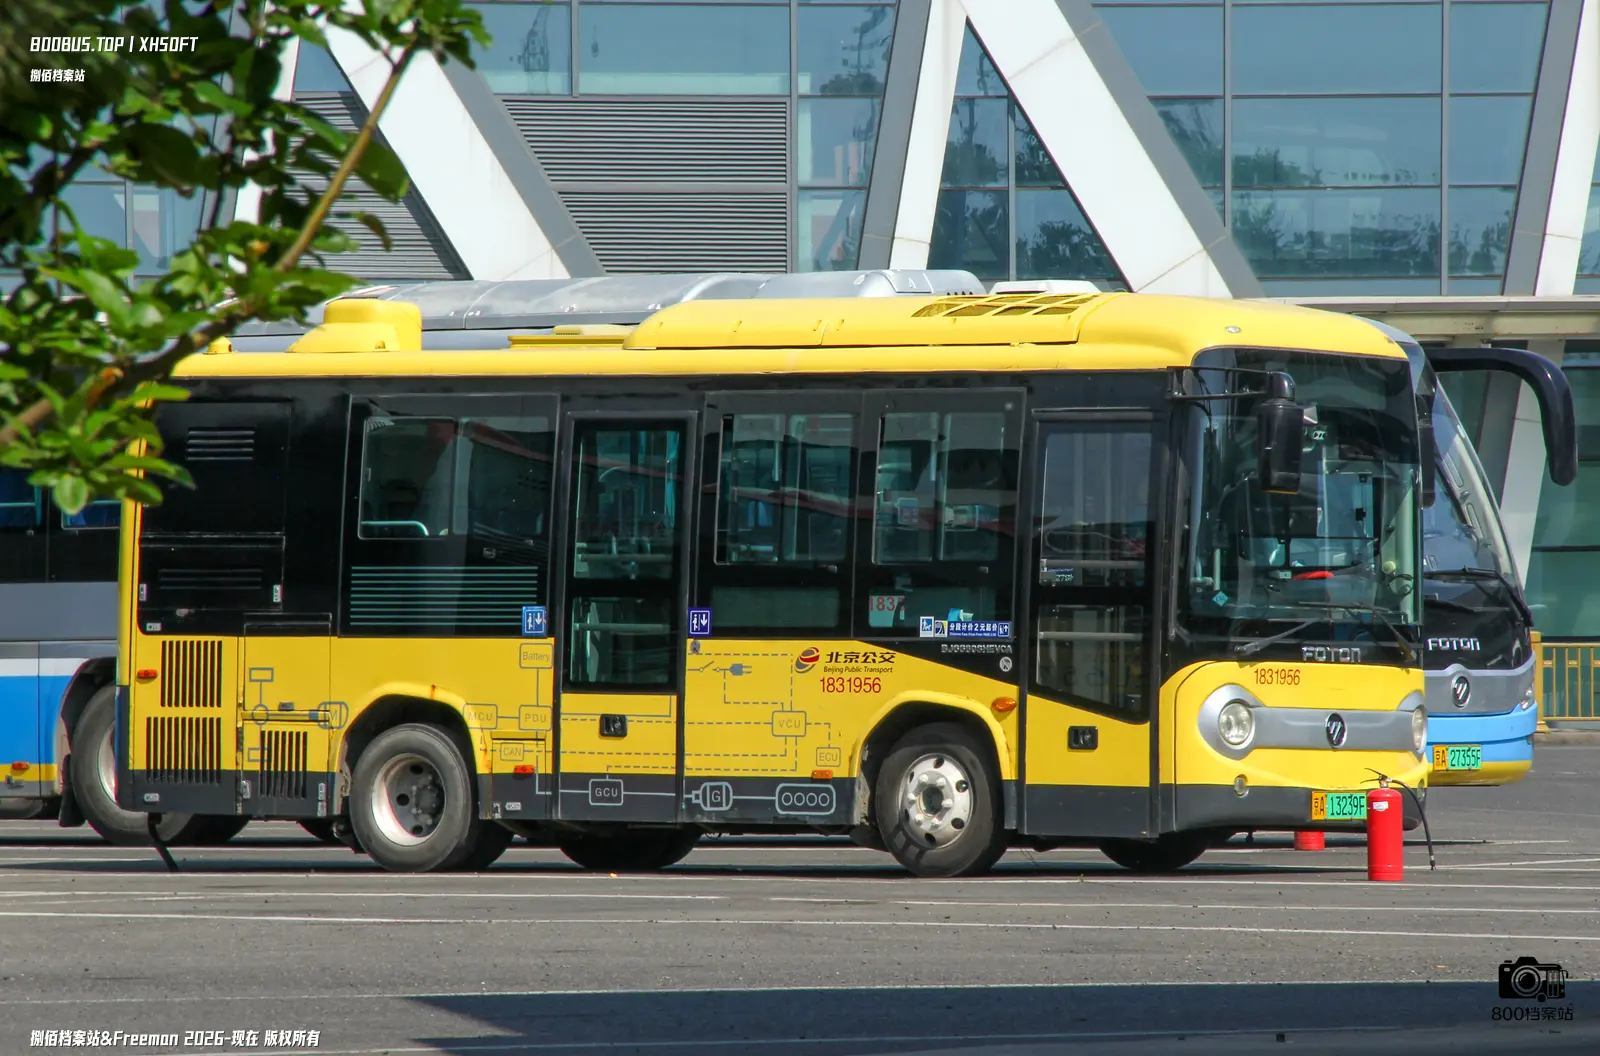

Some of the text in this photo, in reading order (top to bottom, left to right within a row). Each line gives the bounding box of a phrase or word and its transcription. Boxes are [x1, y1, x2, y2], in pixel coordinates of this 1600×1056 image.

[1427, 637, 1481, 651] FOTON
[522, 651, 550, 663] Battery
[825, 651, 897, 664] 北京公交
[1302, 646, 1361, 662] FOTON
[823, 665, 893, 675] Beijing Public Transport
[1254, 668, 1301, 686] 1831956
[820, 676, 882, 694] 1831956
[468, 711, 493, 721] MCU
[524, 713, 547, 723] PDU
[778, 719, 801, 729] VCU
[502, 747, 521, 757] CAN
[819, 752, 838, 762] ECU
[594, 787, 618, 798] GCU
[711, 790, 721, 803] G
